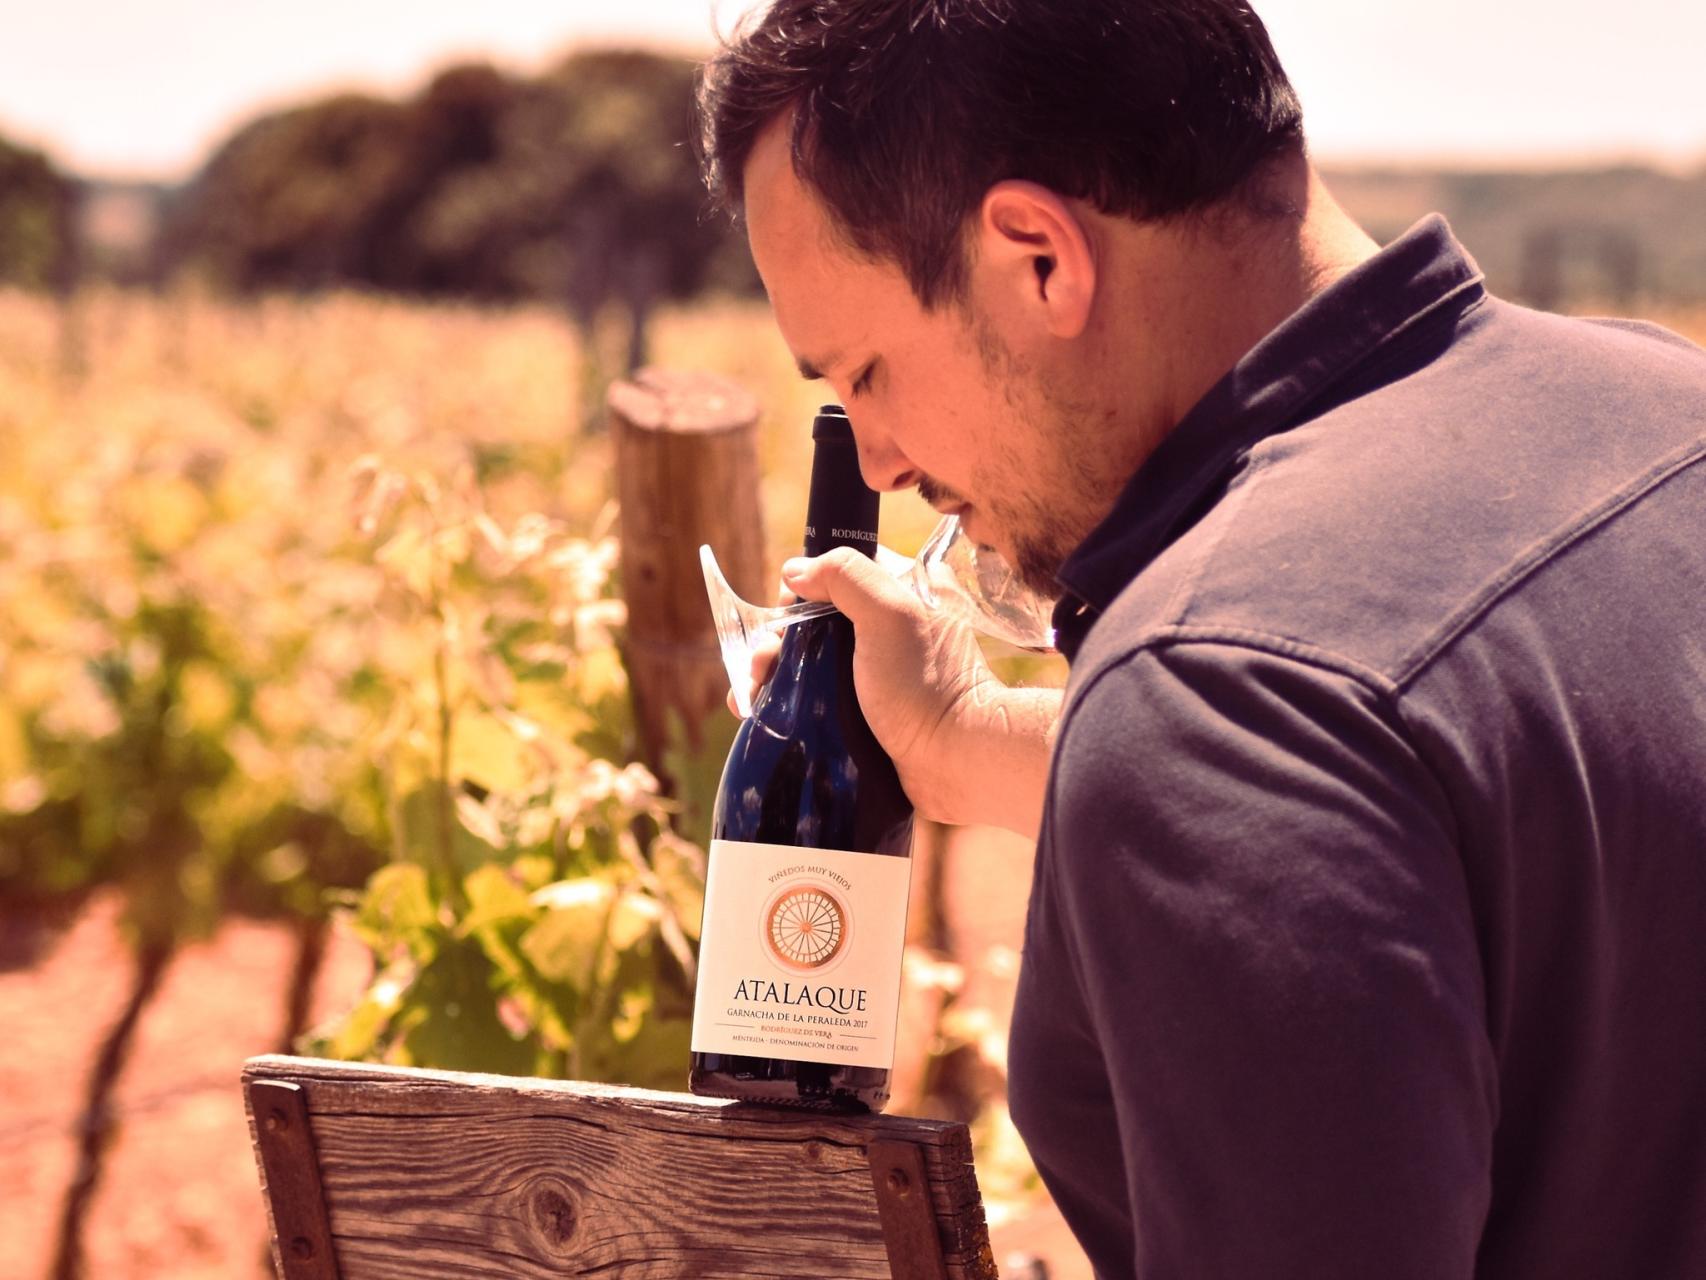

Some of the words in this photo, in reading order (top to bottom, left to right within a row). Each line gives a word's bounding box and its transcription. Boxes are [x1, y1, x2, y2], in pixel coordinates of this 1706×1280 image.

[807, 865, 827, 875] MUY
[828, 870, 851, 890] VIEJOS
[733, 979, 867, 1014] ATALAQUE
[727, 1008, 774, 1020] GARNACHA
[777, 1012, 790, 1021] DE
[793, 1013, 804, 1023] LA
[807, 1015, 851, 1027] PERALEDA
[853, 1019, 868, 1029] 2017
[814, 1030, 832, 1039] VERA
[836, 1044, 859, 1052] ORIGEN
